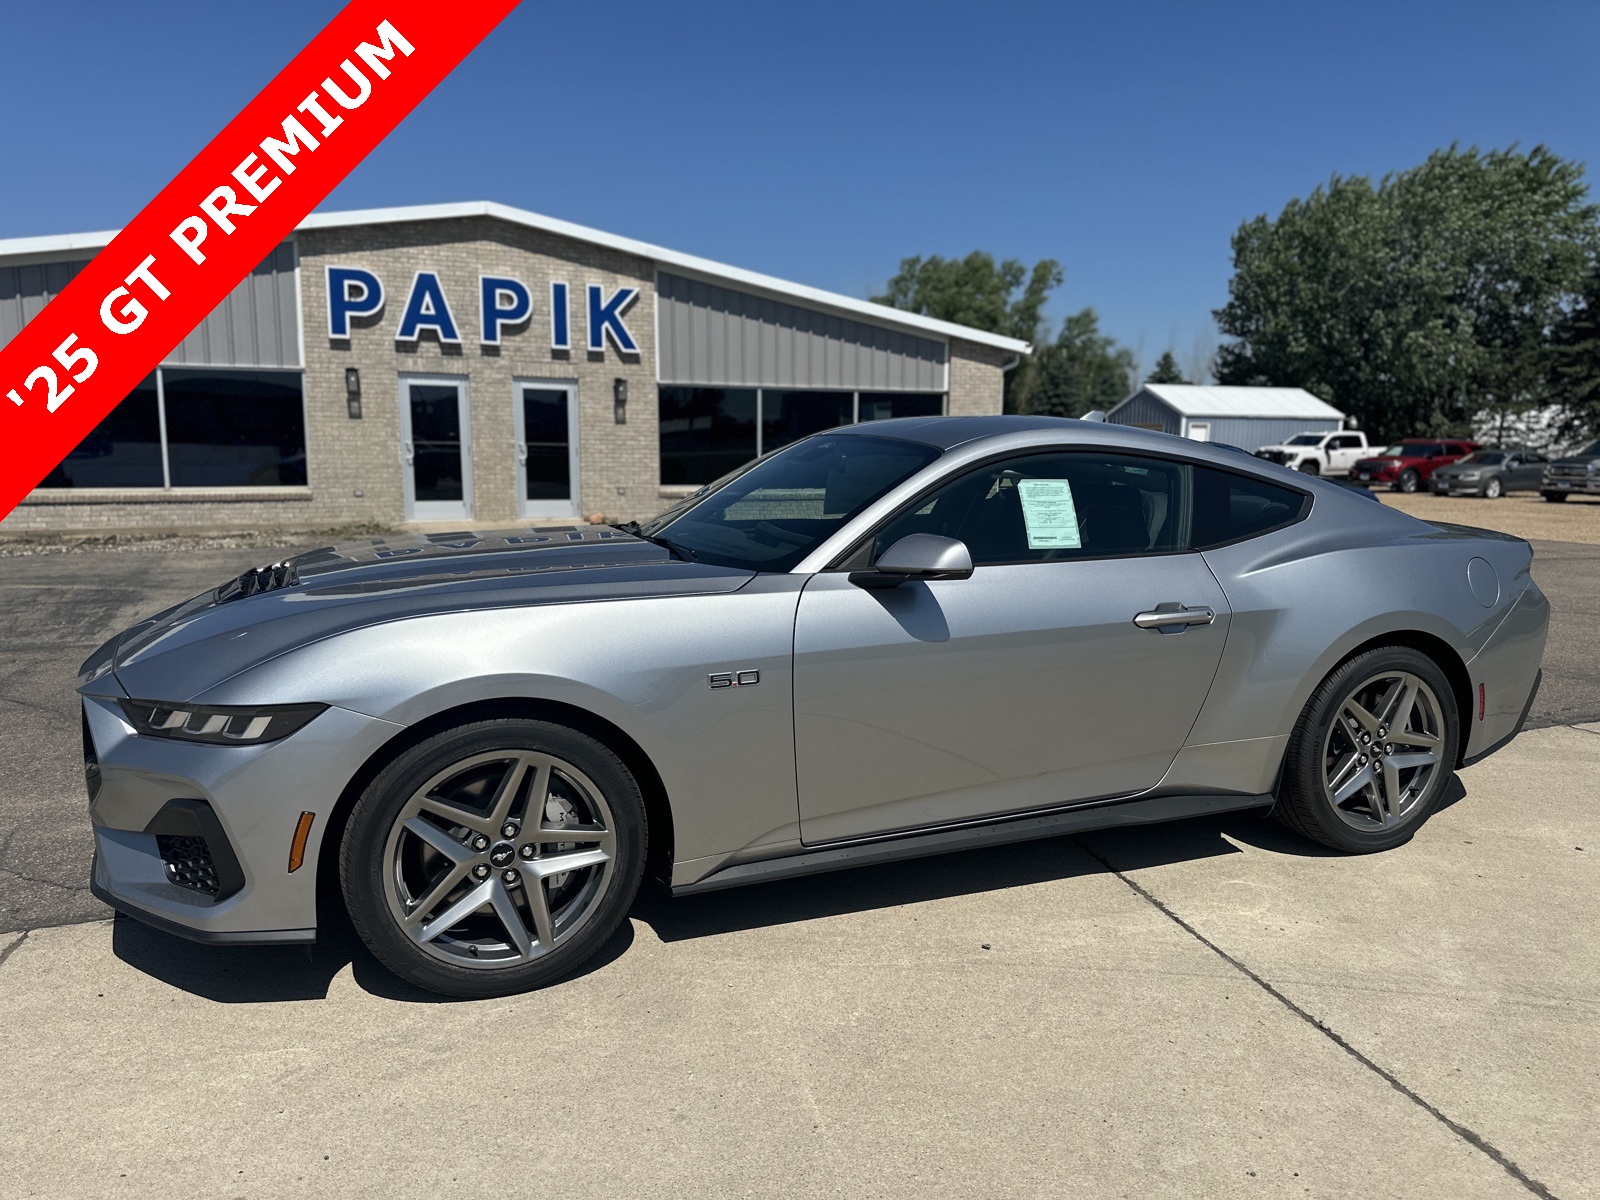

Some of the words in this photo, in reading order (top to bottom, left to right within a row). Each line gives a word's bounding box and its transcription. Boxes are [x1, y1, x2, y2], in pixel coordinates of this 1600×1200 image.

[325, 265, 641, 354] PAPIK
[707, 669, 761, 690] 5.0
[1311, 741, 1321, 785] Continental
